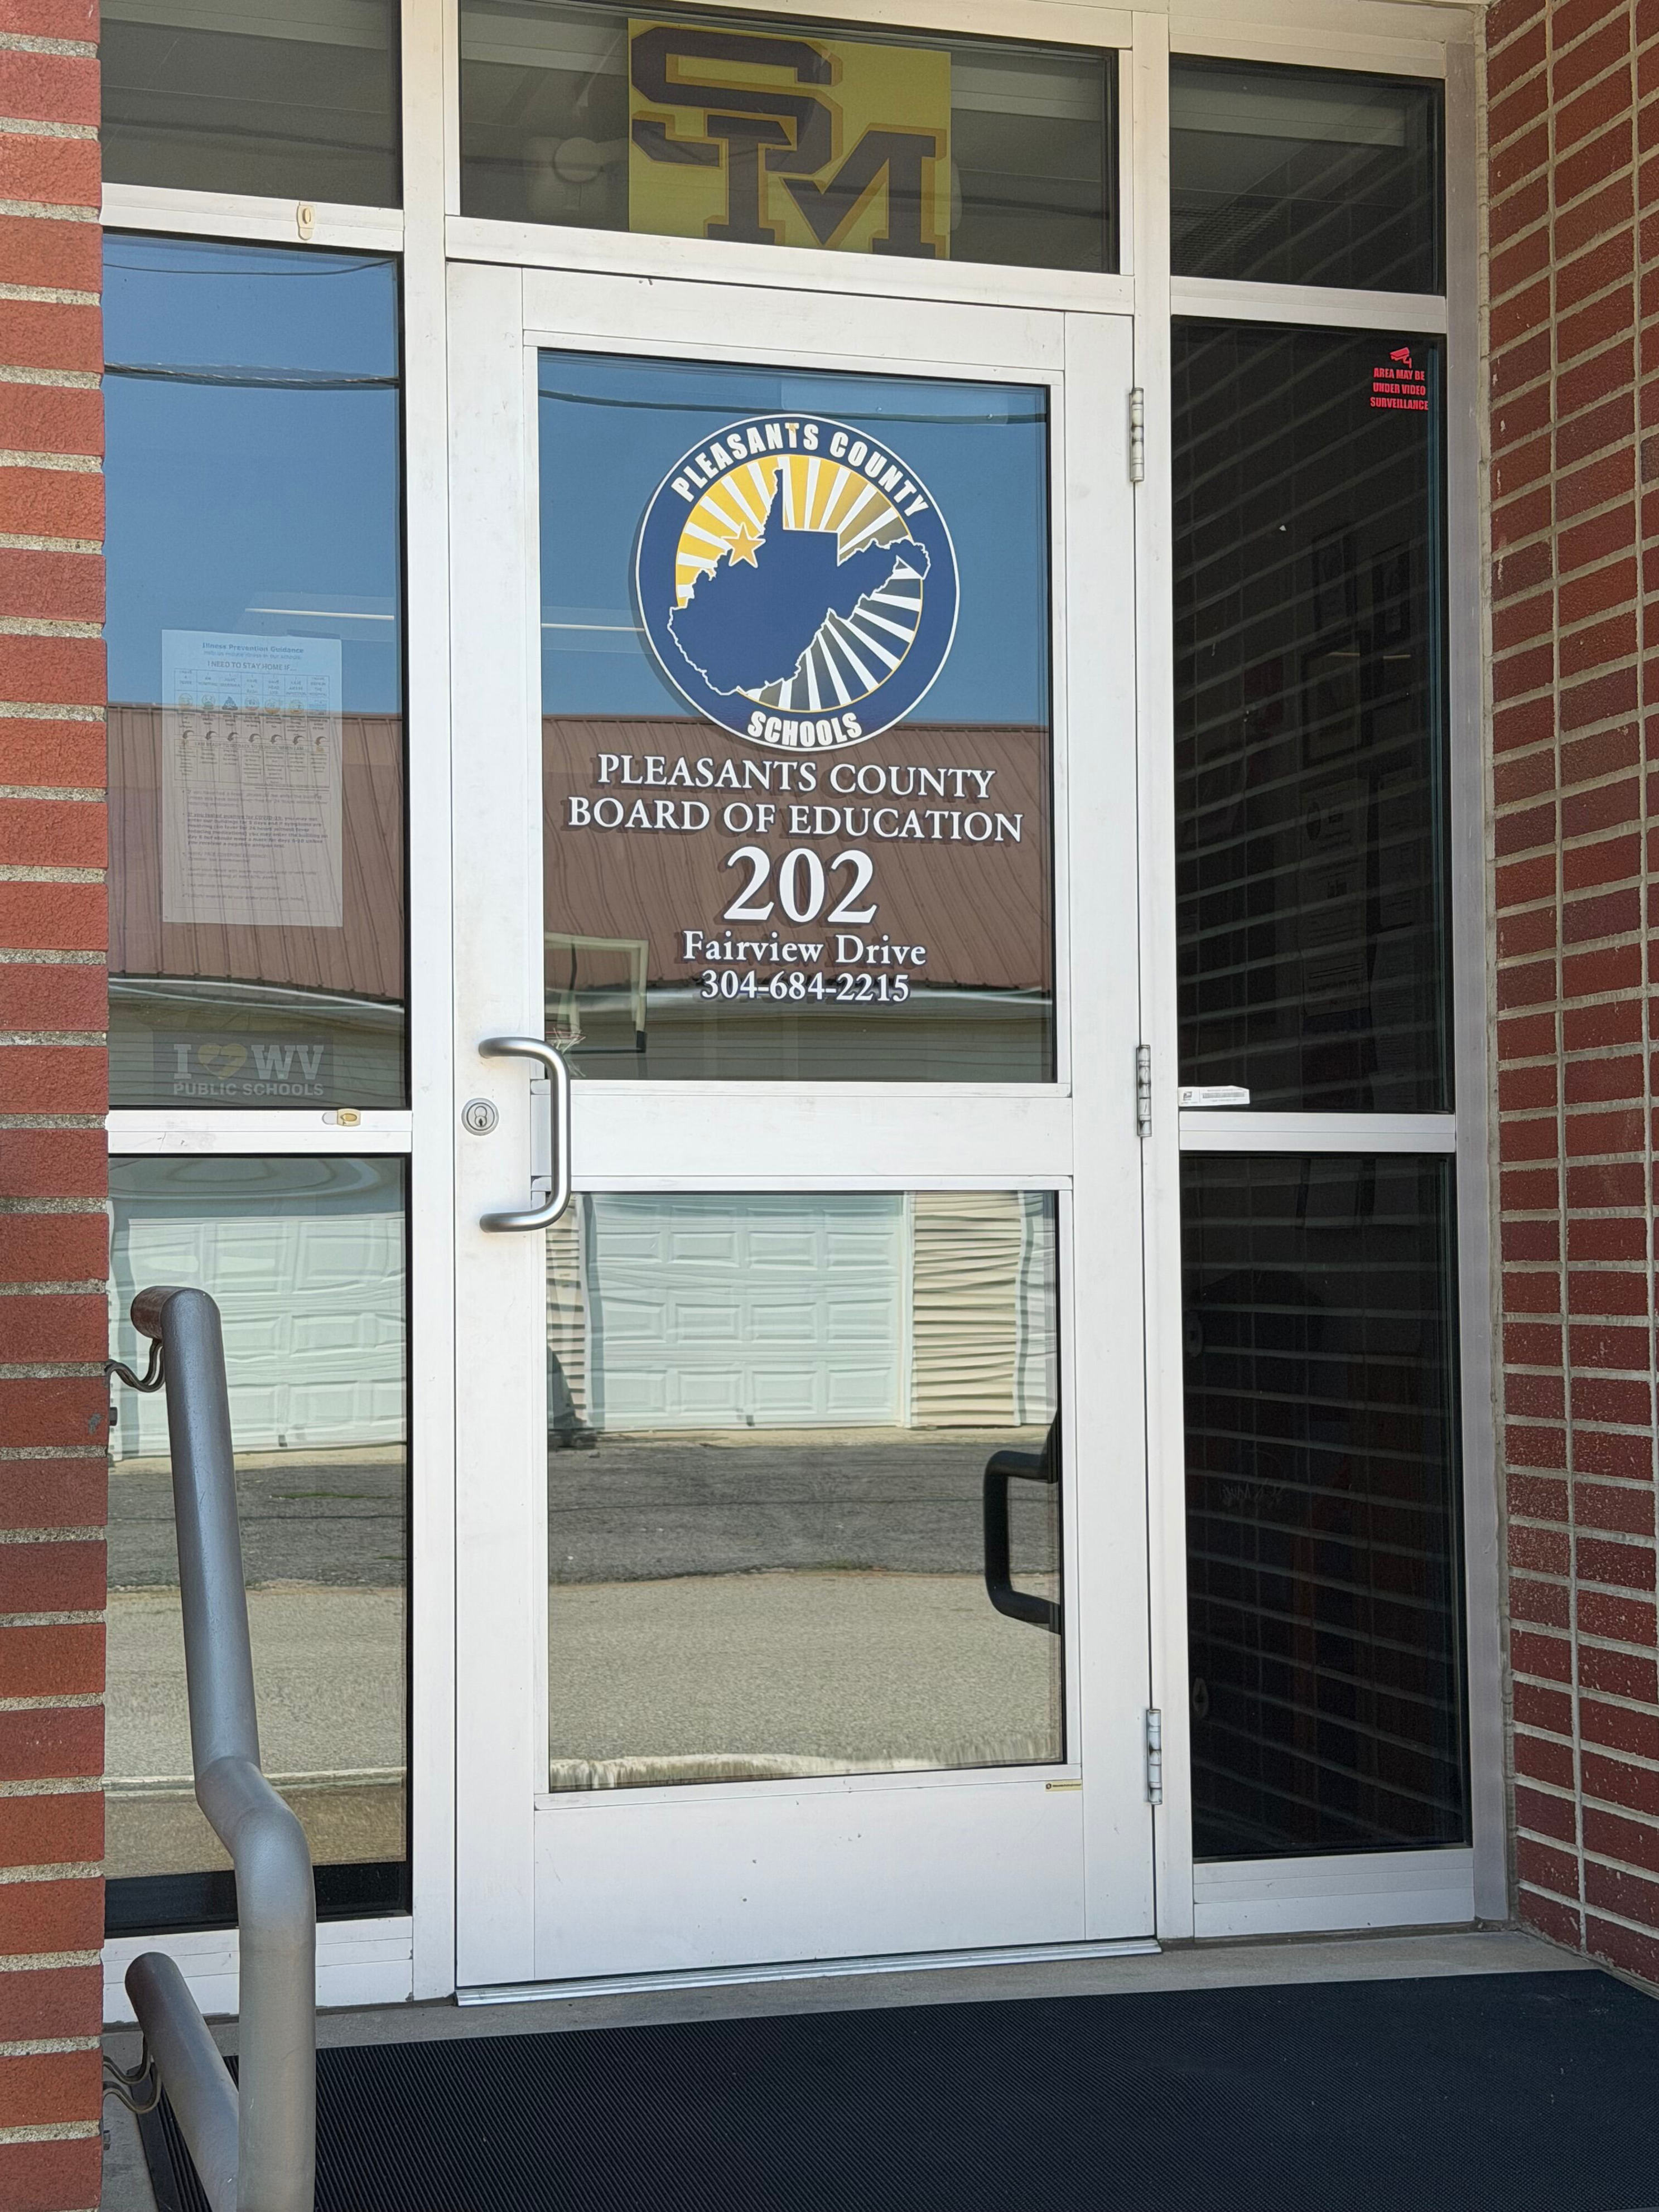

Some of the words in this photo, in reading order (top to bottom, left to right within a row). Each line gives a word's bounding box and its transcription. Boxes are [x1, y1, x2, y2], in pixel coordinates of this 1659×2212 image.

[1373, 368, 1395, 379] AREA
[1396, 369, 1413, 380] MAY
[1415, 370, 1425, 380] BE
[1373, 382, 1400, 393] UNDER
[1401, 384, 1426, 395] VIDEO
[1370, 397, 1429, 410] SURVEILLANCE
[671, 422, 819, 503] PLEASANTS
[829, 432, 929, 517] COUNTY
[747, 711, 862, 747] SCHOOLS
[598, 754, 816, 791] PLEASANTS
[830, 763, 996, 798] COUNTY
[568, 796, 710, 830] BOARD
[724, 802, 775, 833] OF
[789, 805, 1024, 842] EDUCATION
[723, 846, 877, 923] 202
[683, 930, 824, 963] Fairview
[835, 934, 926, 964] Drive
[701, 969, 910, 1002] 304-684-2215
[173, 1044, 191, 1079] I
[251, 1045, 324, 1080] WV
[173, 1083, 237, 1095] PUBLIC
[243, 1083, 324, 1096] SCHOOLS
